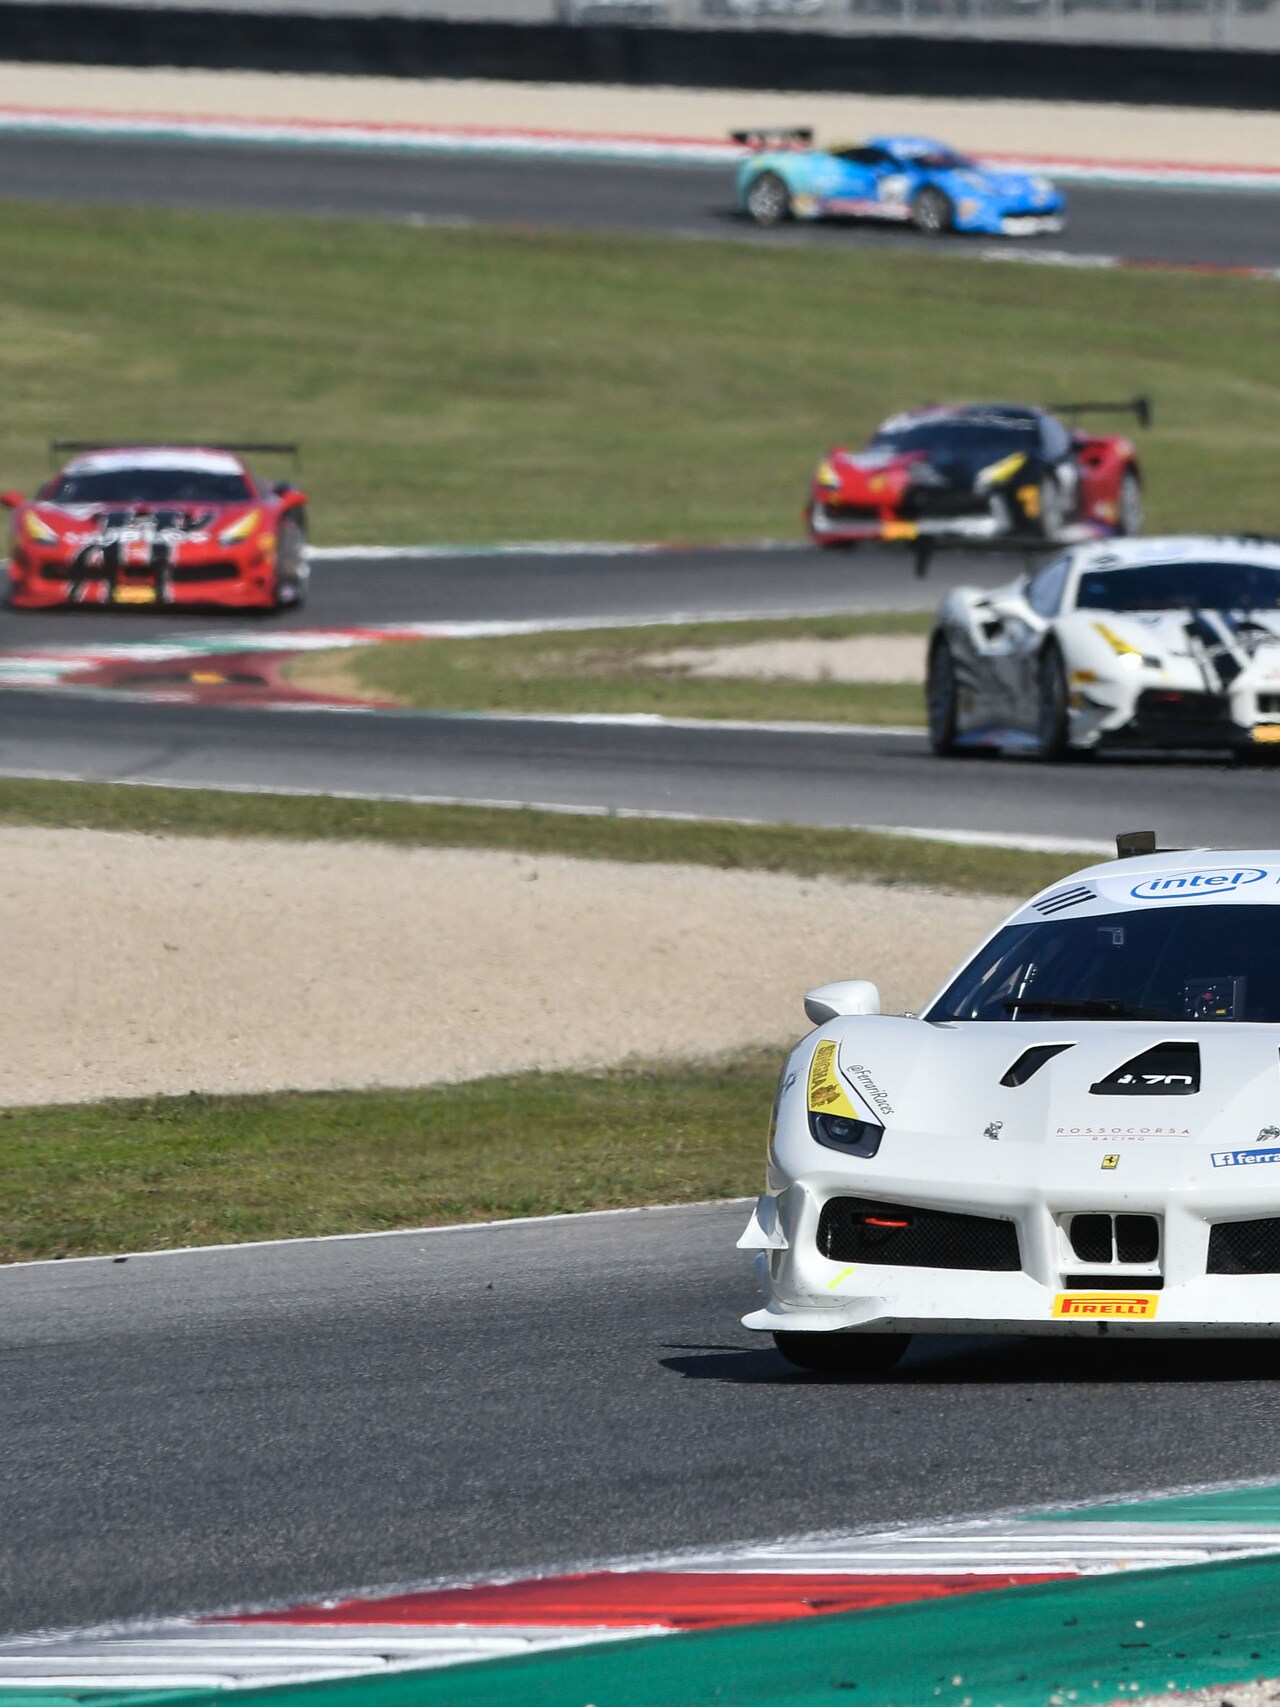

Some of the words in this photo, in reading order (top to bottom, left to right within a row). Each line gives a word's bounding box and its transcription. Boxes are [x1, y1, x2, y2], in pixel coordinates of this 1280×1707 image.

[1149, 872, 1244, 890] intel
[811, 1044, 836, 1091] SINGHA
[1056, 1127, 1190, 1135] ROSSOCORSA
[1061, 1298, 1149, 1314] PIRELLI
